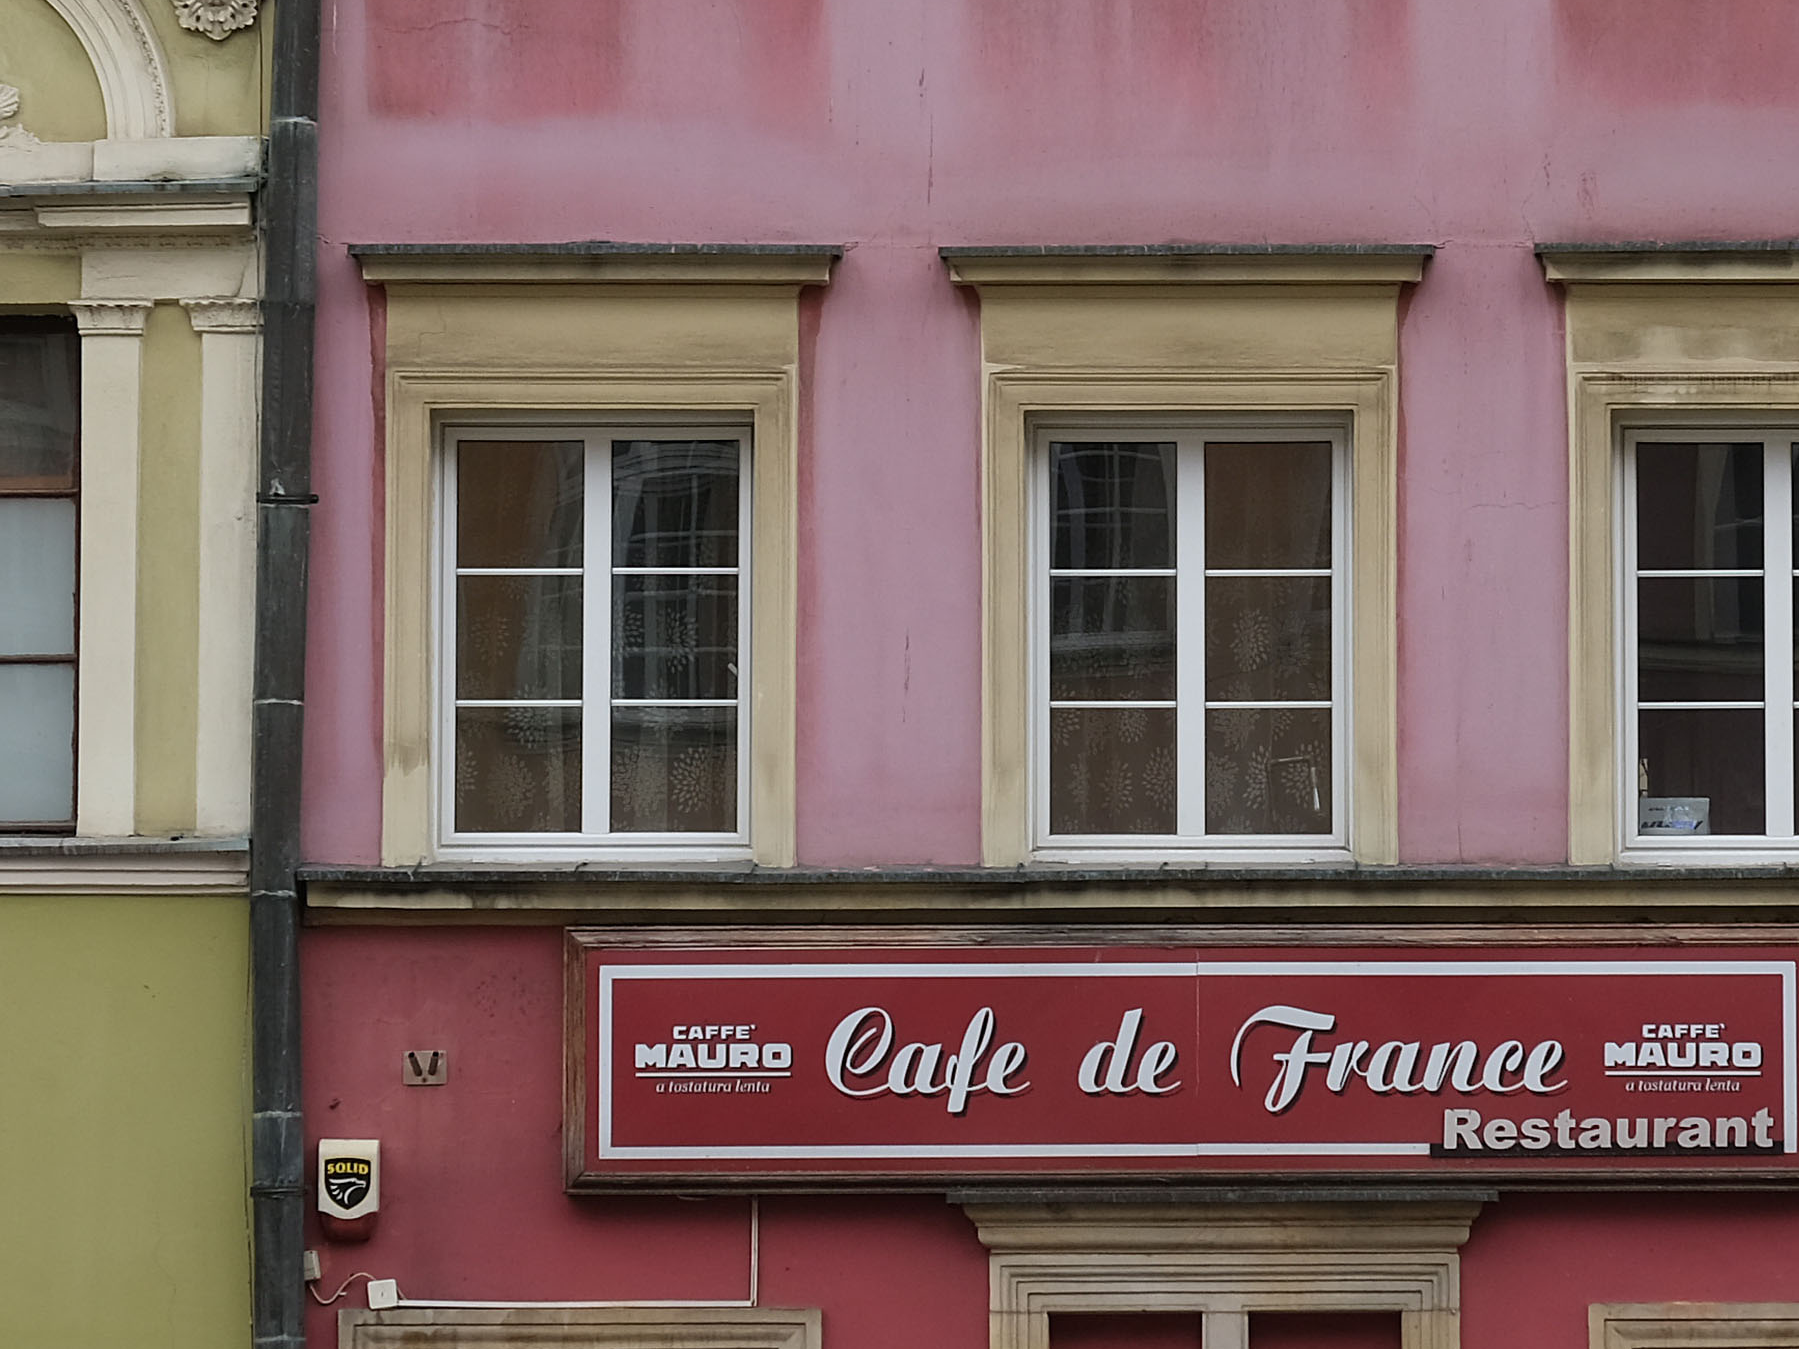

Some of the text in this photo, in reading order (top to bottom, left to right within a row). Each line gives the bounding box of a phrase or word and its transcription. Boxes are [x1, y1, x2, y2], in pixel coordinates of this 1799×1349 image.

[634, 1043, 792, 1069] MAURO
[824, 1004, 1568, 1114] Cafe de France
[1604, 1041, 1762, 1068] MAURO
[735, 1078, 770, 1093] lenta
[1705, 1077, 1740, 1092] lenta
[1443, 1106, 1775, 1150] Restaurant
[327, 1162, 369, 1175] SOLID
